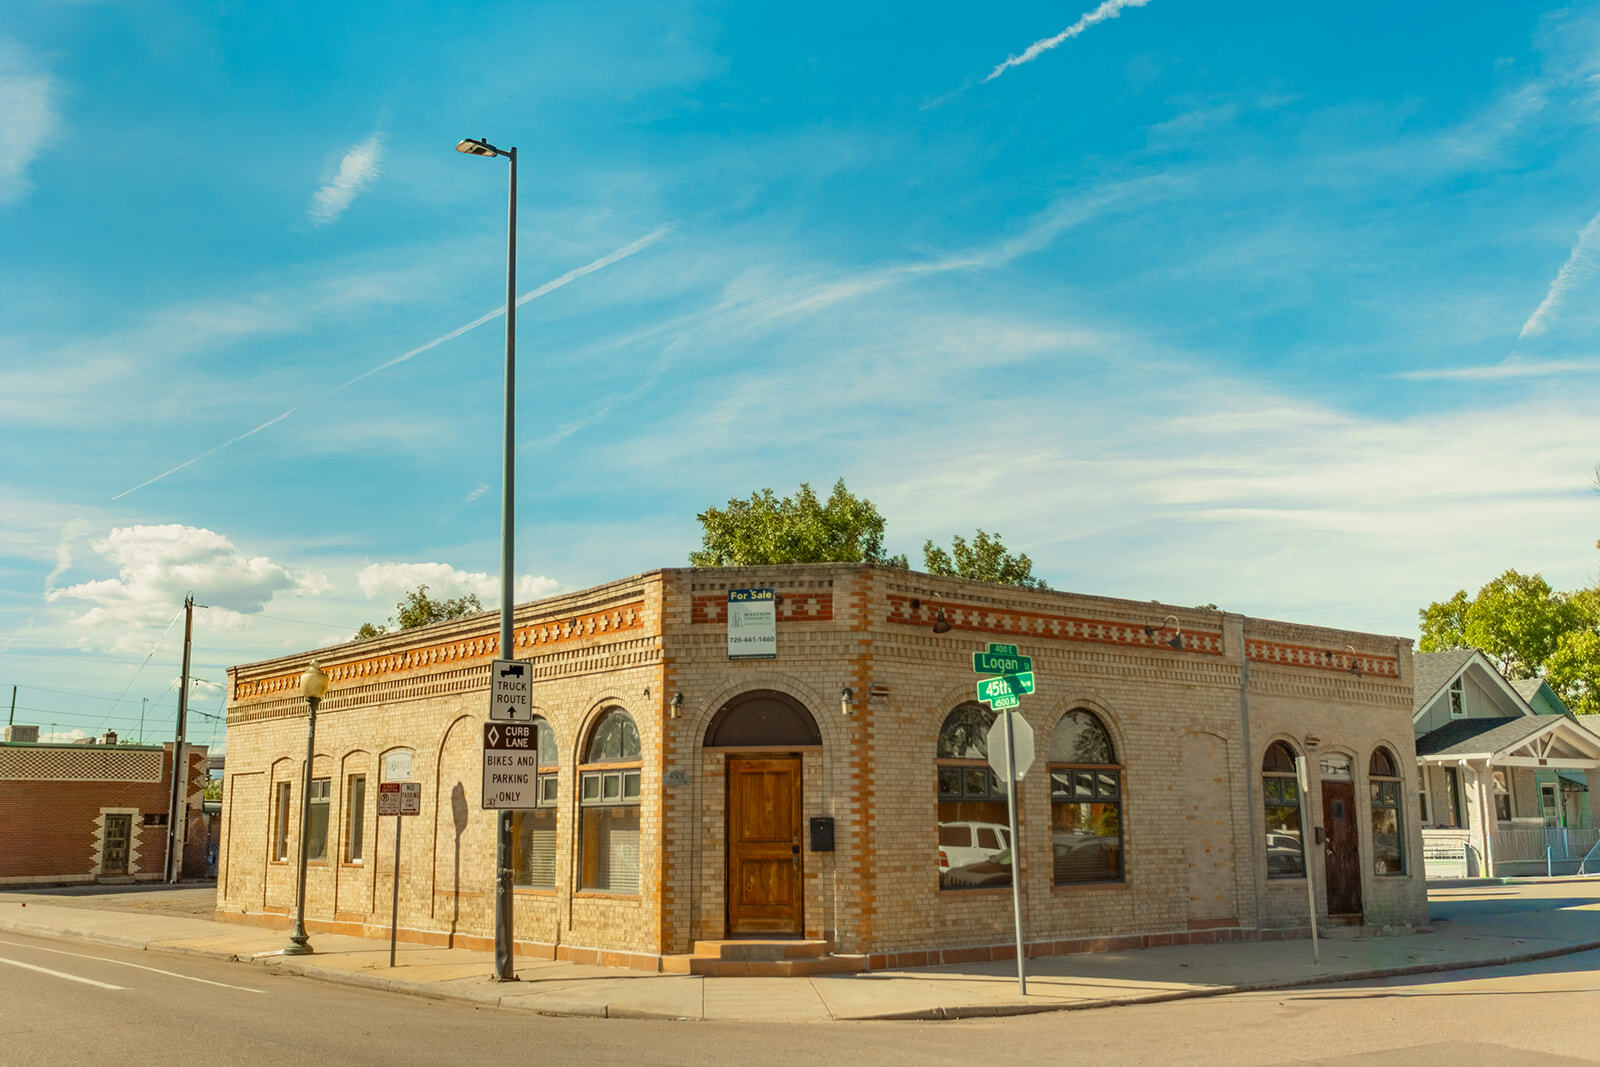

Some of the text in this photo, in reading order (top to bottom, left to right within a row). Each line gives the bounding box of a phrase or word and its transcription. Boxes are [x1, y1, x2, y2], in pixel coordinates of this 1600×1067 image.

[730, 590, 772, 600] For Sale
[982, 654, 1018, 672] Logan
[498, 681, 527, 691] TRUCK
[986, 680, 1012, 696] 45th
[497, 694, 526, 704] ROUTE
[506, 726, 530, 736] CURB
[506, 738, 528, 748] LANE
[487, 756, 534, 766] BIKES AND
[492, 773, 528, 784] PARKING
[499, 792, 520, 802] ONLY
